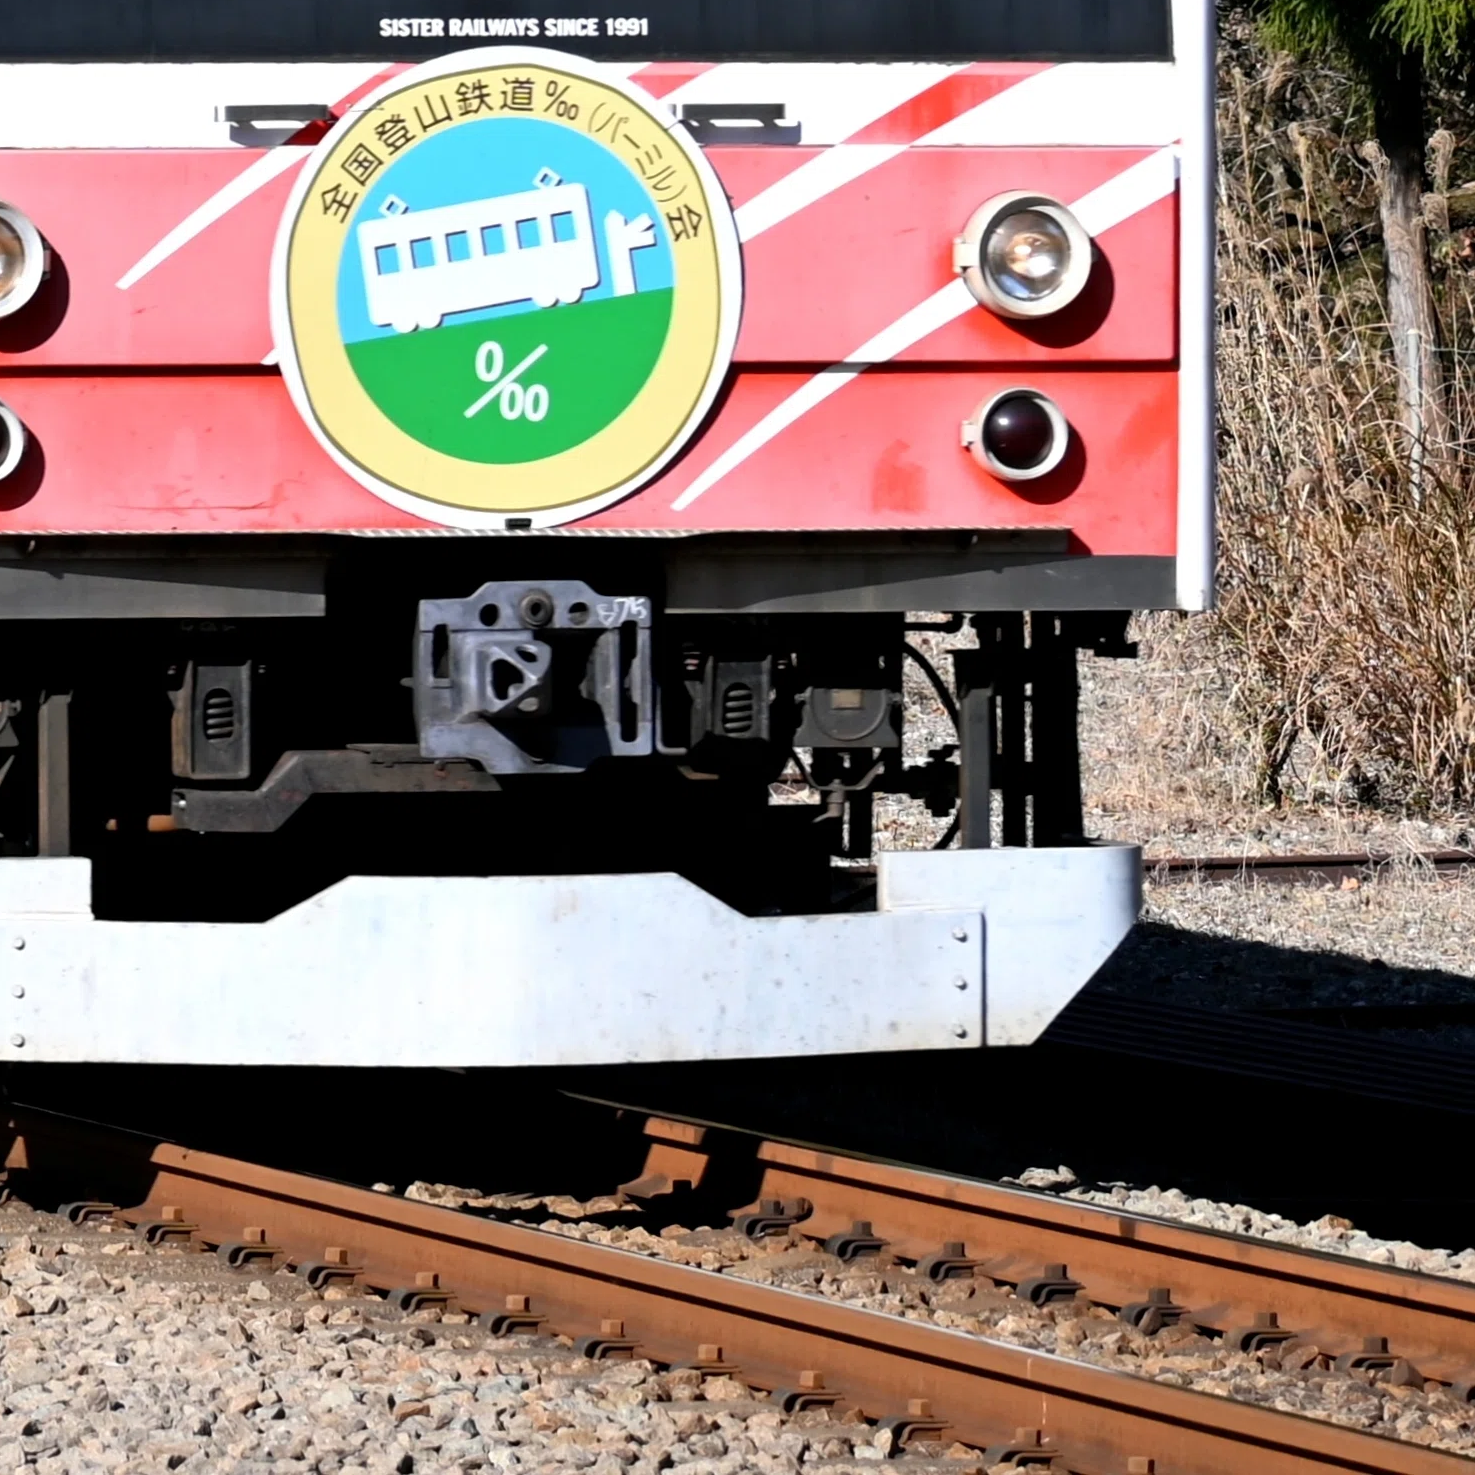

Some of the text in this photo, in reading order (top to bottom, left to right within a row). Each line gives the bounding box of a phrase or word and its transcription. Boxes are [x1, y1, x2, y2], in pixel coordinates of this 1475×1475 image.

[379, 18, 648, 37] SISTER RAILWAYS SINCE 1991
